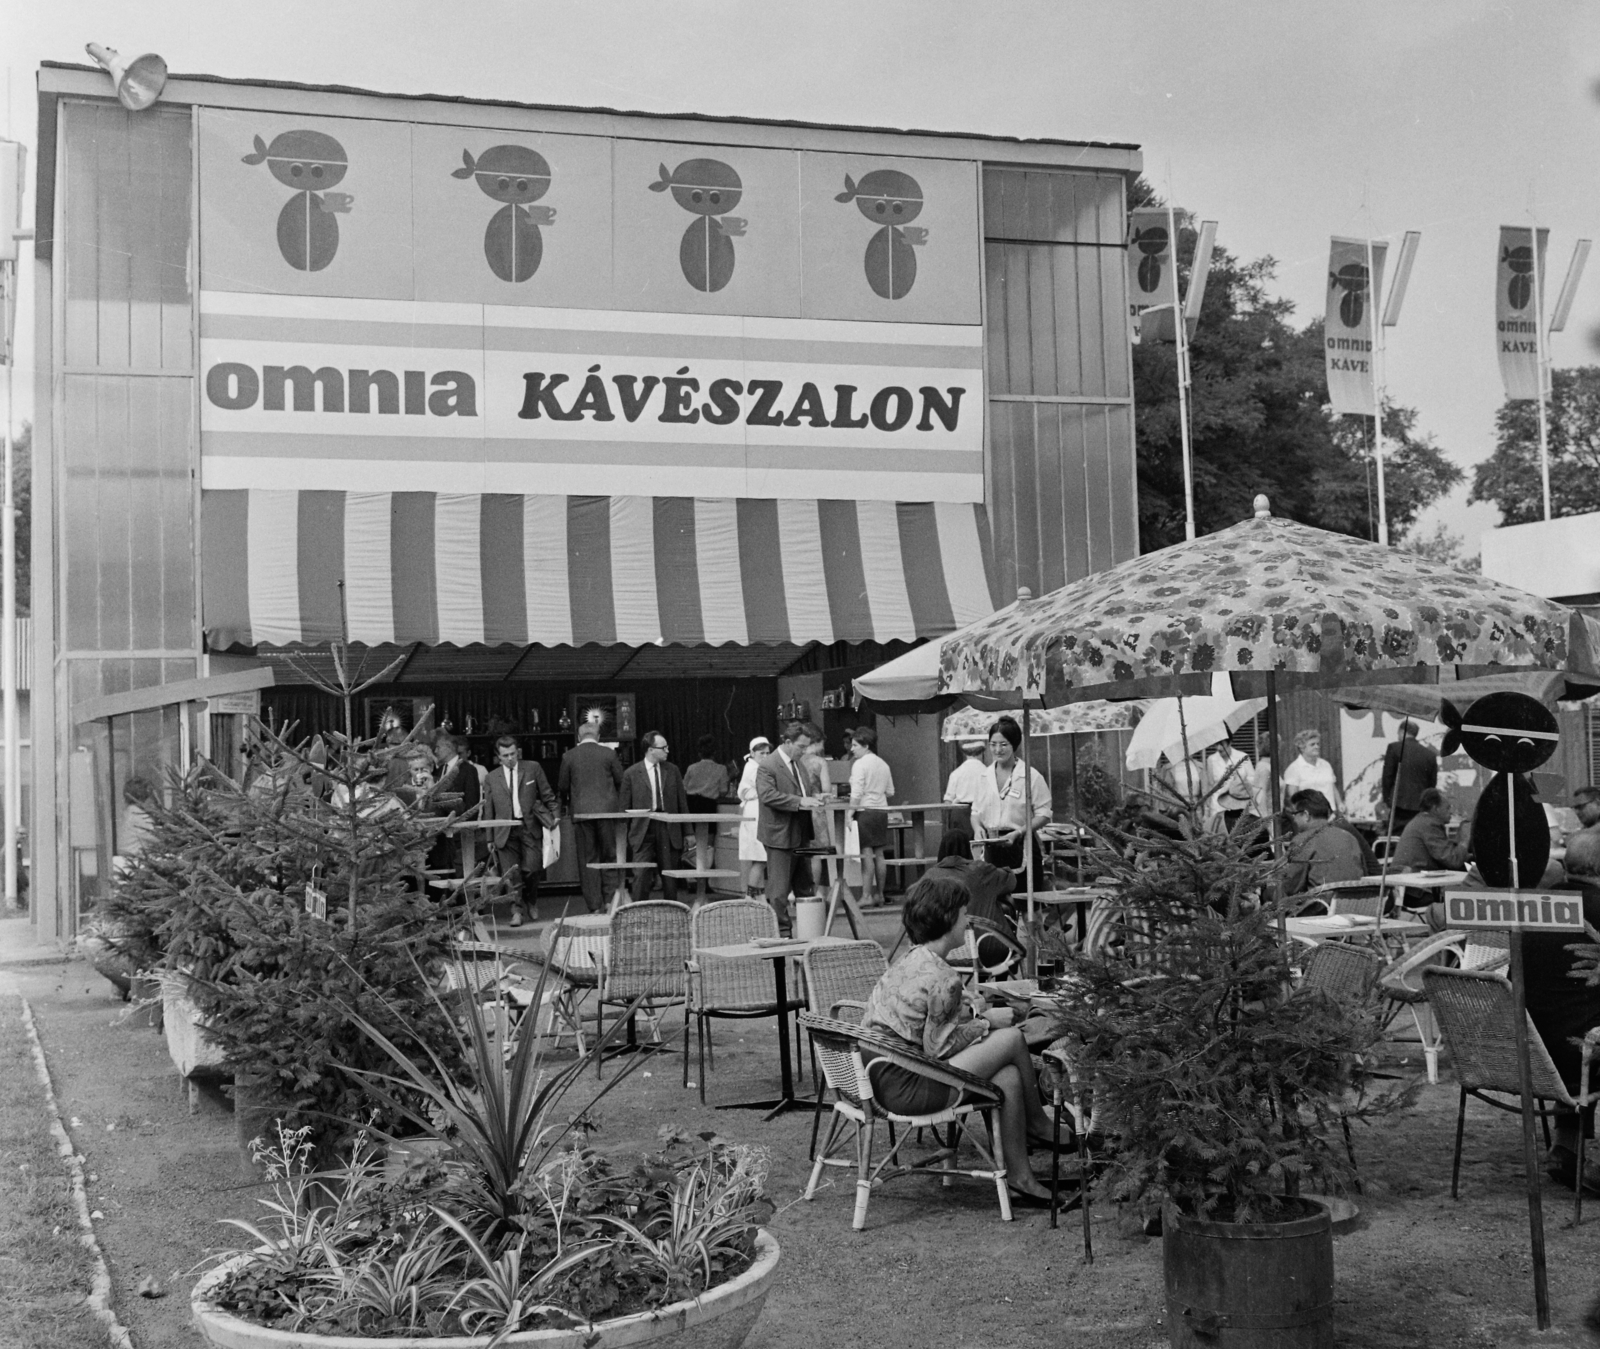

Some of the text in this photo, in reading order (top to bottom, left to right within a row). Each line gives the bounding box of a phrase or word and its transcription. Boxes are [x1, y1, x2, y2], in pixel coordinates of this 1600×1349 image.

[206, 361, 966, 432] omnia KÁVÉSZALON
[1450, 896, 1580, 924] omnia
